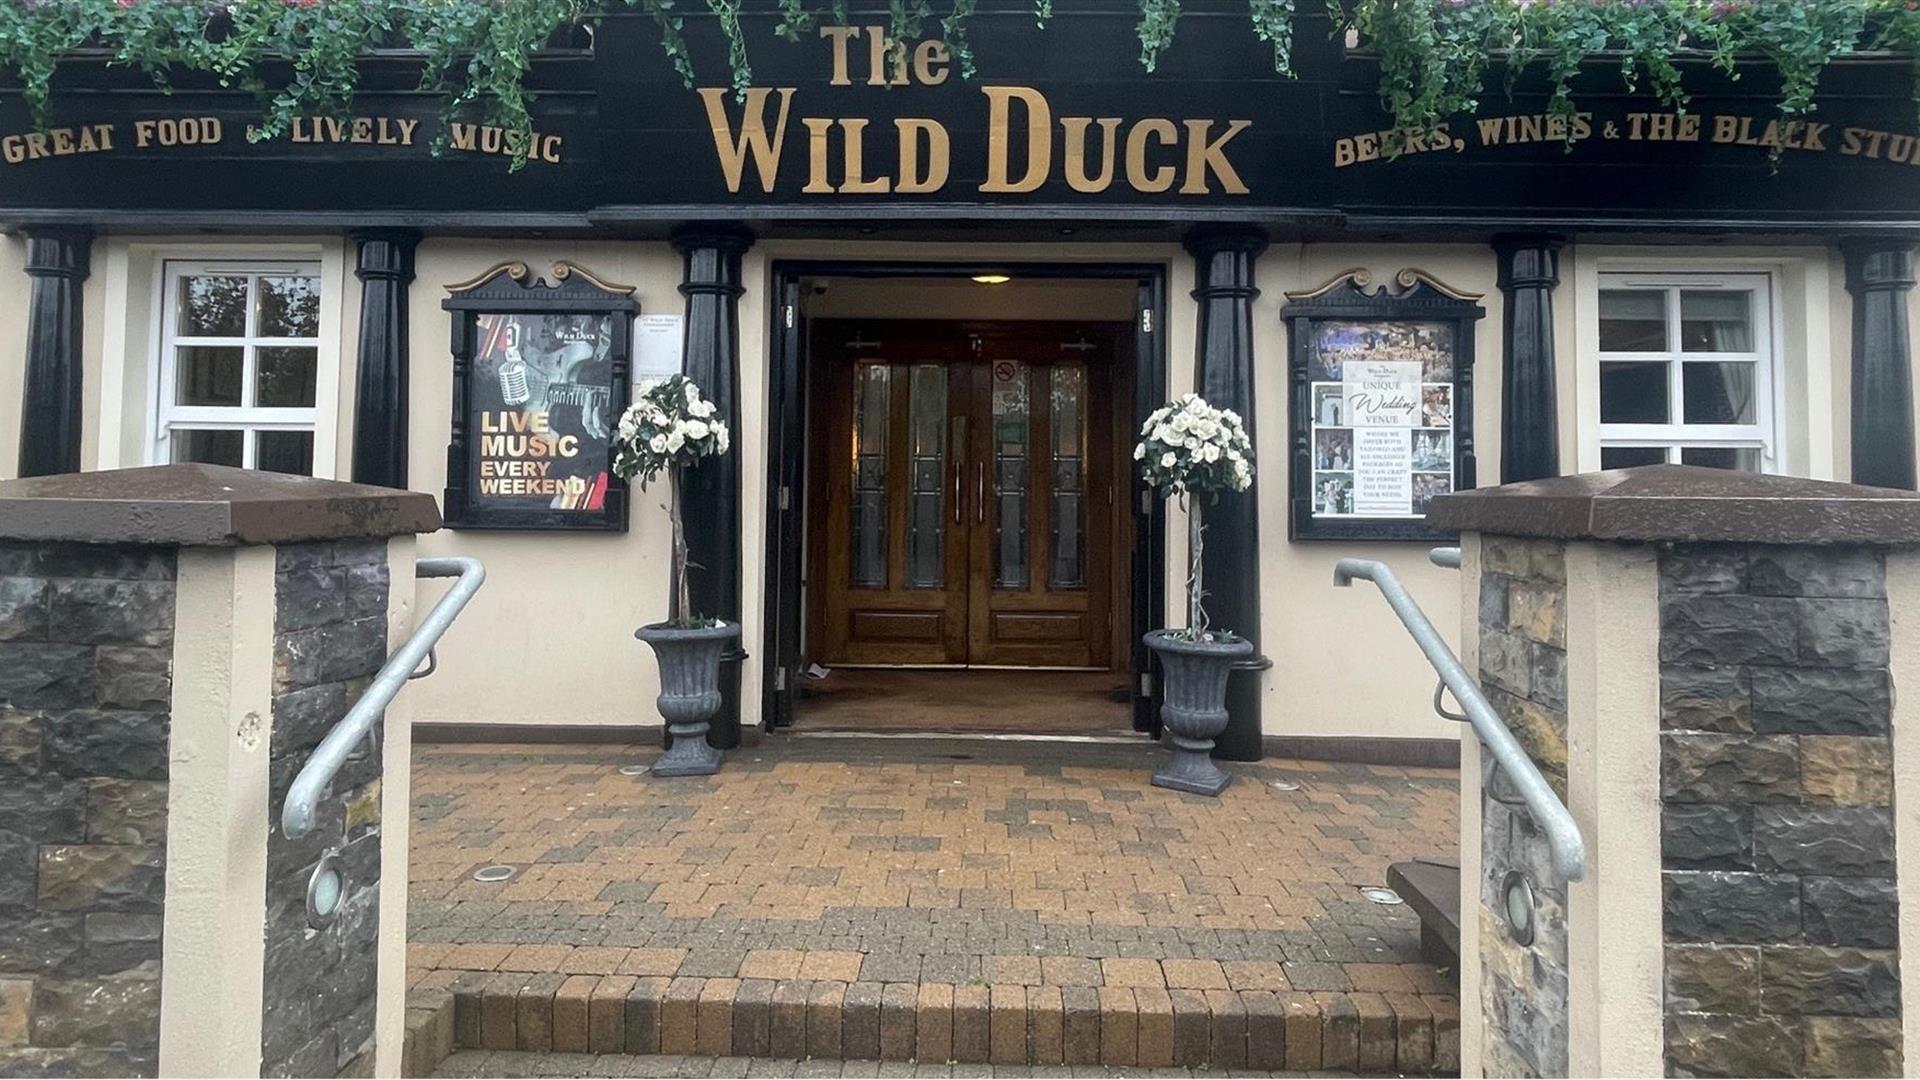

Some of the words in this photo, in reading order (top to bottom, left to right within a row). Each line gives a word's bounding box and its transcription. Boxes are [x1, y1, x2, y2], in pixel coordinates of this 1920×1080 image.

[820, 26, 950, 85] The
[2, 124, 114, 163] GREAT
[134, 117, 222, 147] FOOD
[292, 116, 418, 145] LIVELY
[450, 123, 561, 163] MUSIC
[697, 88, 950, 193] WILD
[979, 86, 1252, 194] DUCK
[1476, 112, 1592, 146] WINES
[1603, 120, 1620, 139] &
[1627, 113, 1700, 141] THE
[1712, 115, 1829, 151] BLACK
[1363, 381, 1400, 390] UNIQUE
[1349, 392, 1417, 415] Wedding
[482, 411, 549, 432] LIVE
[1366, 416, 1399, 424] VENUE
[481, 435, 578, 457] MUSIC
[481, 461, 551, 476] EVERY
[480, 479, 585, 495] WEEKEND
